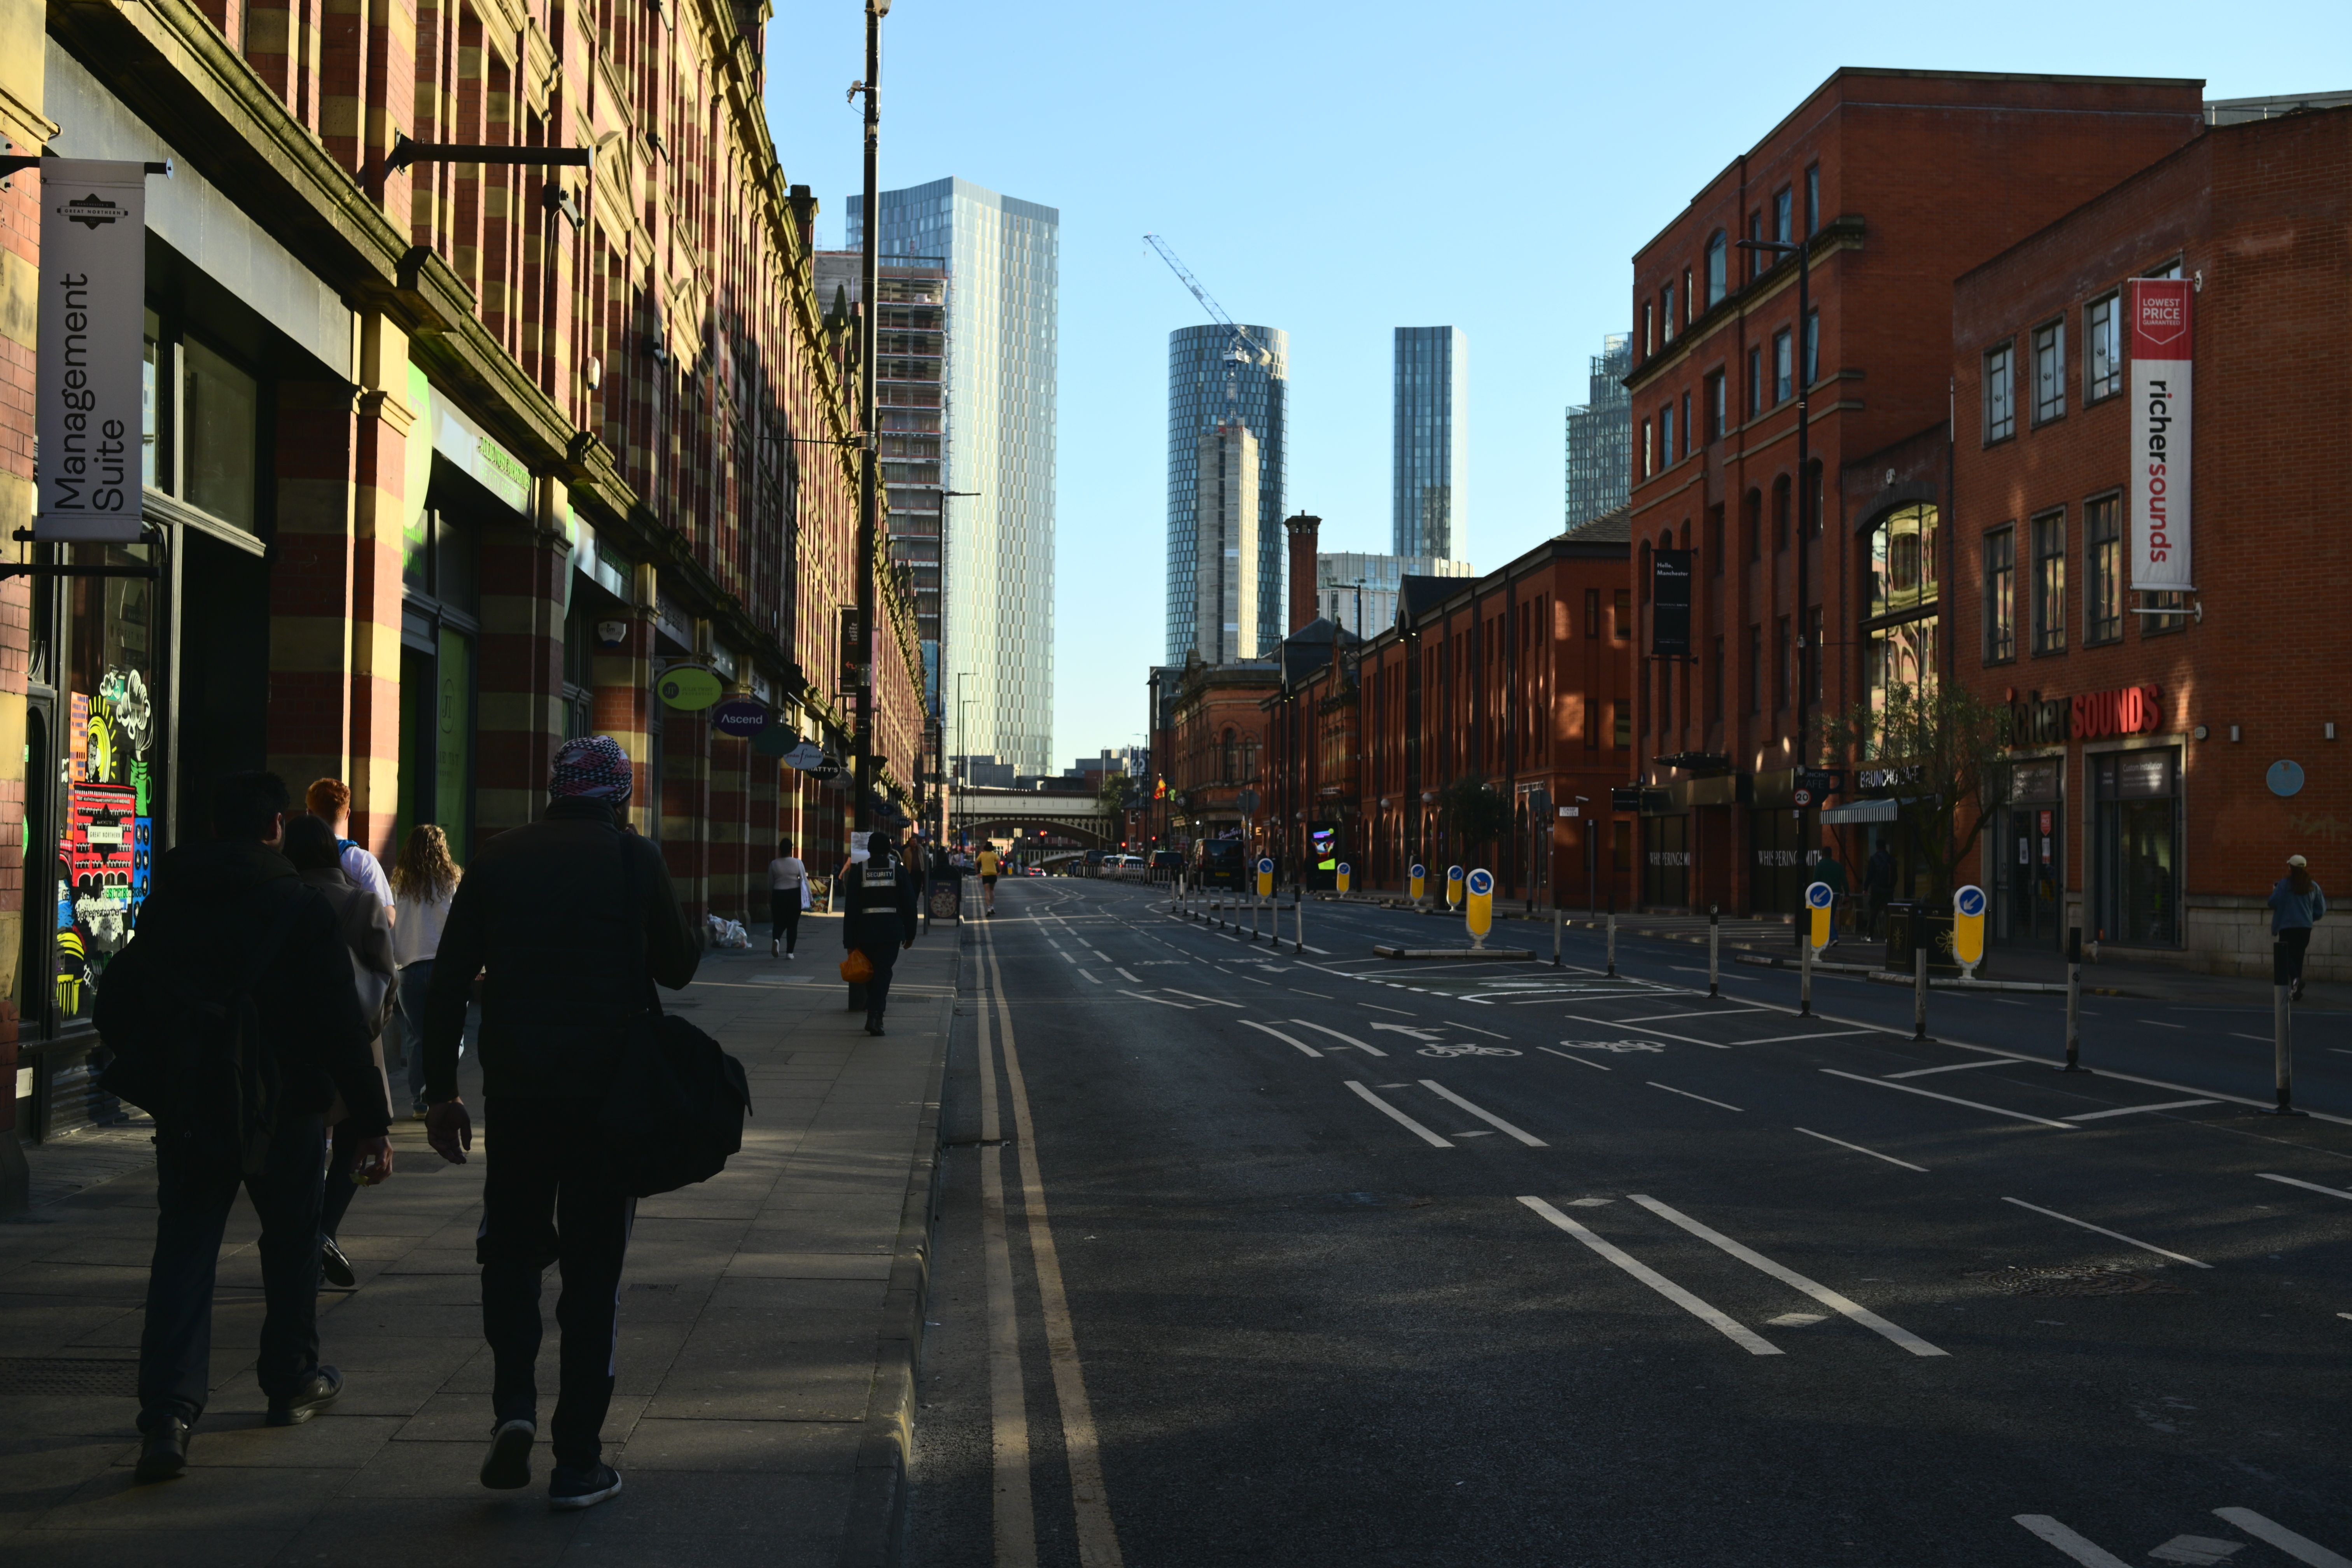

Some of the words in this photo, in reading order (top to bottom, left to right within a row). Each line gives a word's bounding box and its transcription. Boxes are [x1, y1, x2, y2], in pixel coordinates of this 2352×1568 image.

[2143, 298, 2180, 307] LOWEST
[2143, 307, 2180, 320] PRICE
[54, 273, 95, 509] Management
[93, 419, 124, 511] Suite
[2149, 380, 2172, 564] richersounds
[489, 471, 500, 492] CITY
[501, 481, 527, 511] SPECIALIST
[721, 713, 763, 724] Ascend
[2123, 763, 2139, 772] Custom
[2140, 761, 2163, 771] Installation
[1860, 768, 1898, 788] BRUNCHO
[1758, 850, 1822, 866] WHISPERINGMITH
